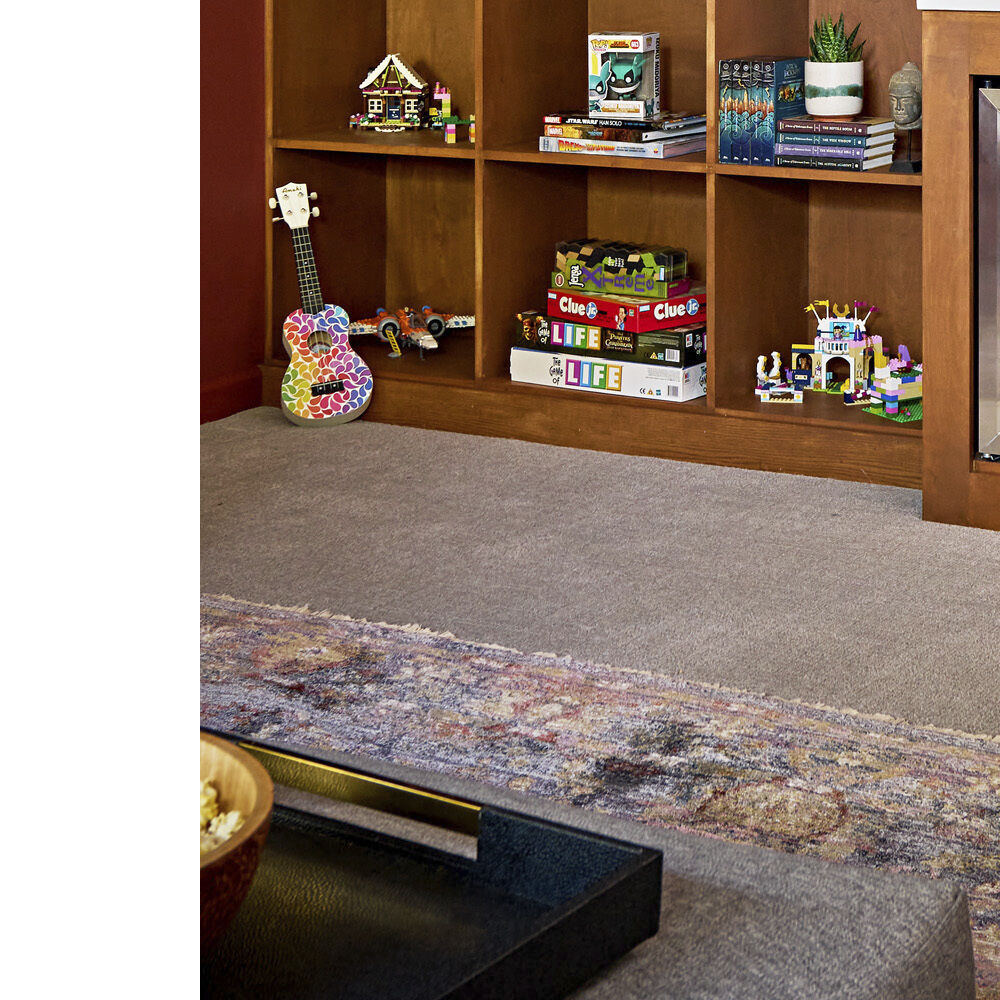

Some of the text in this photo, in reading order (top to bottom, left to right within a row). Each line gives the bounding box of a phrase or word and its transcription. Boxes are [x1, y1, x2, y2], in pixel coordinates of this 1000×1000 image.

[569, 264, 584, 288] Jenga
[559, 296, 586, 316] Clue
[654, 301, 686, 320] Clue
[552, 324, 599, 348] LIFE
[568, 362, 619, 389] LIFE
